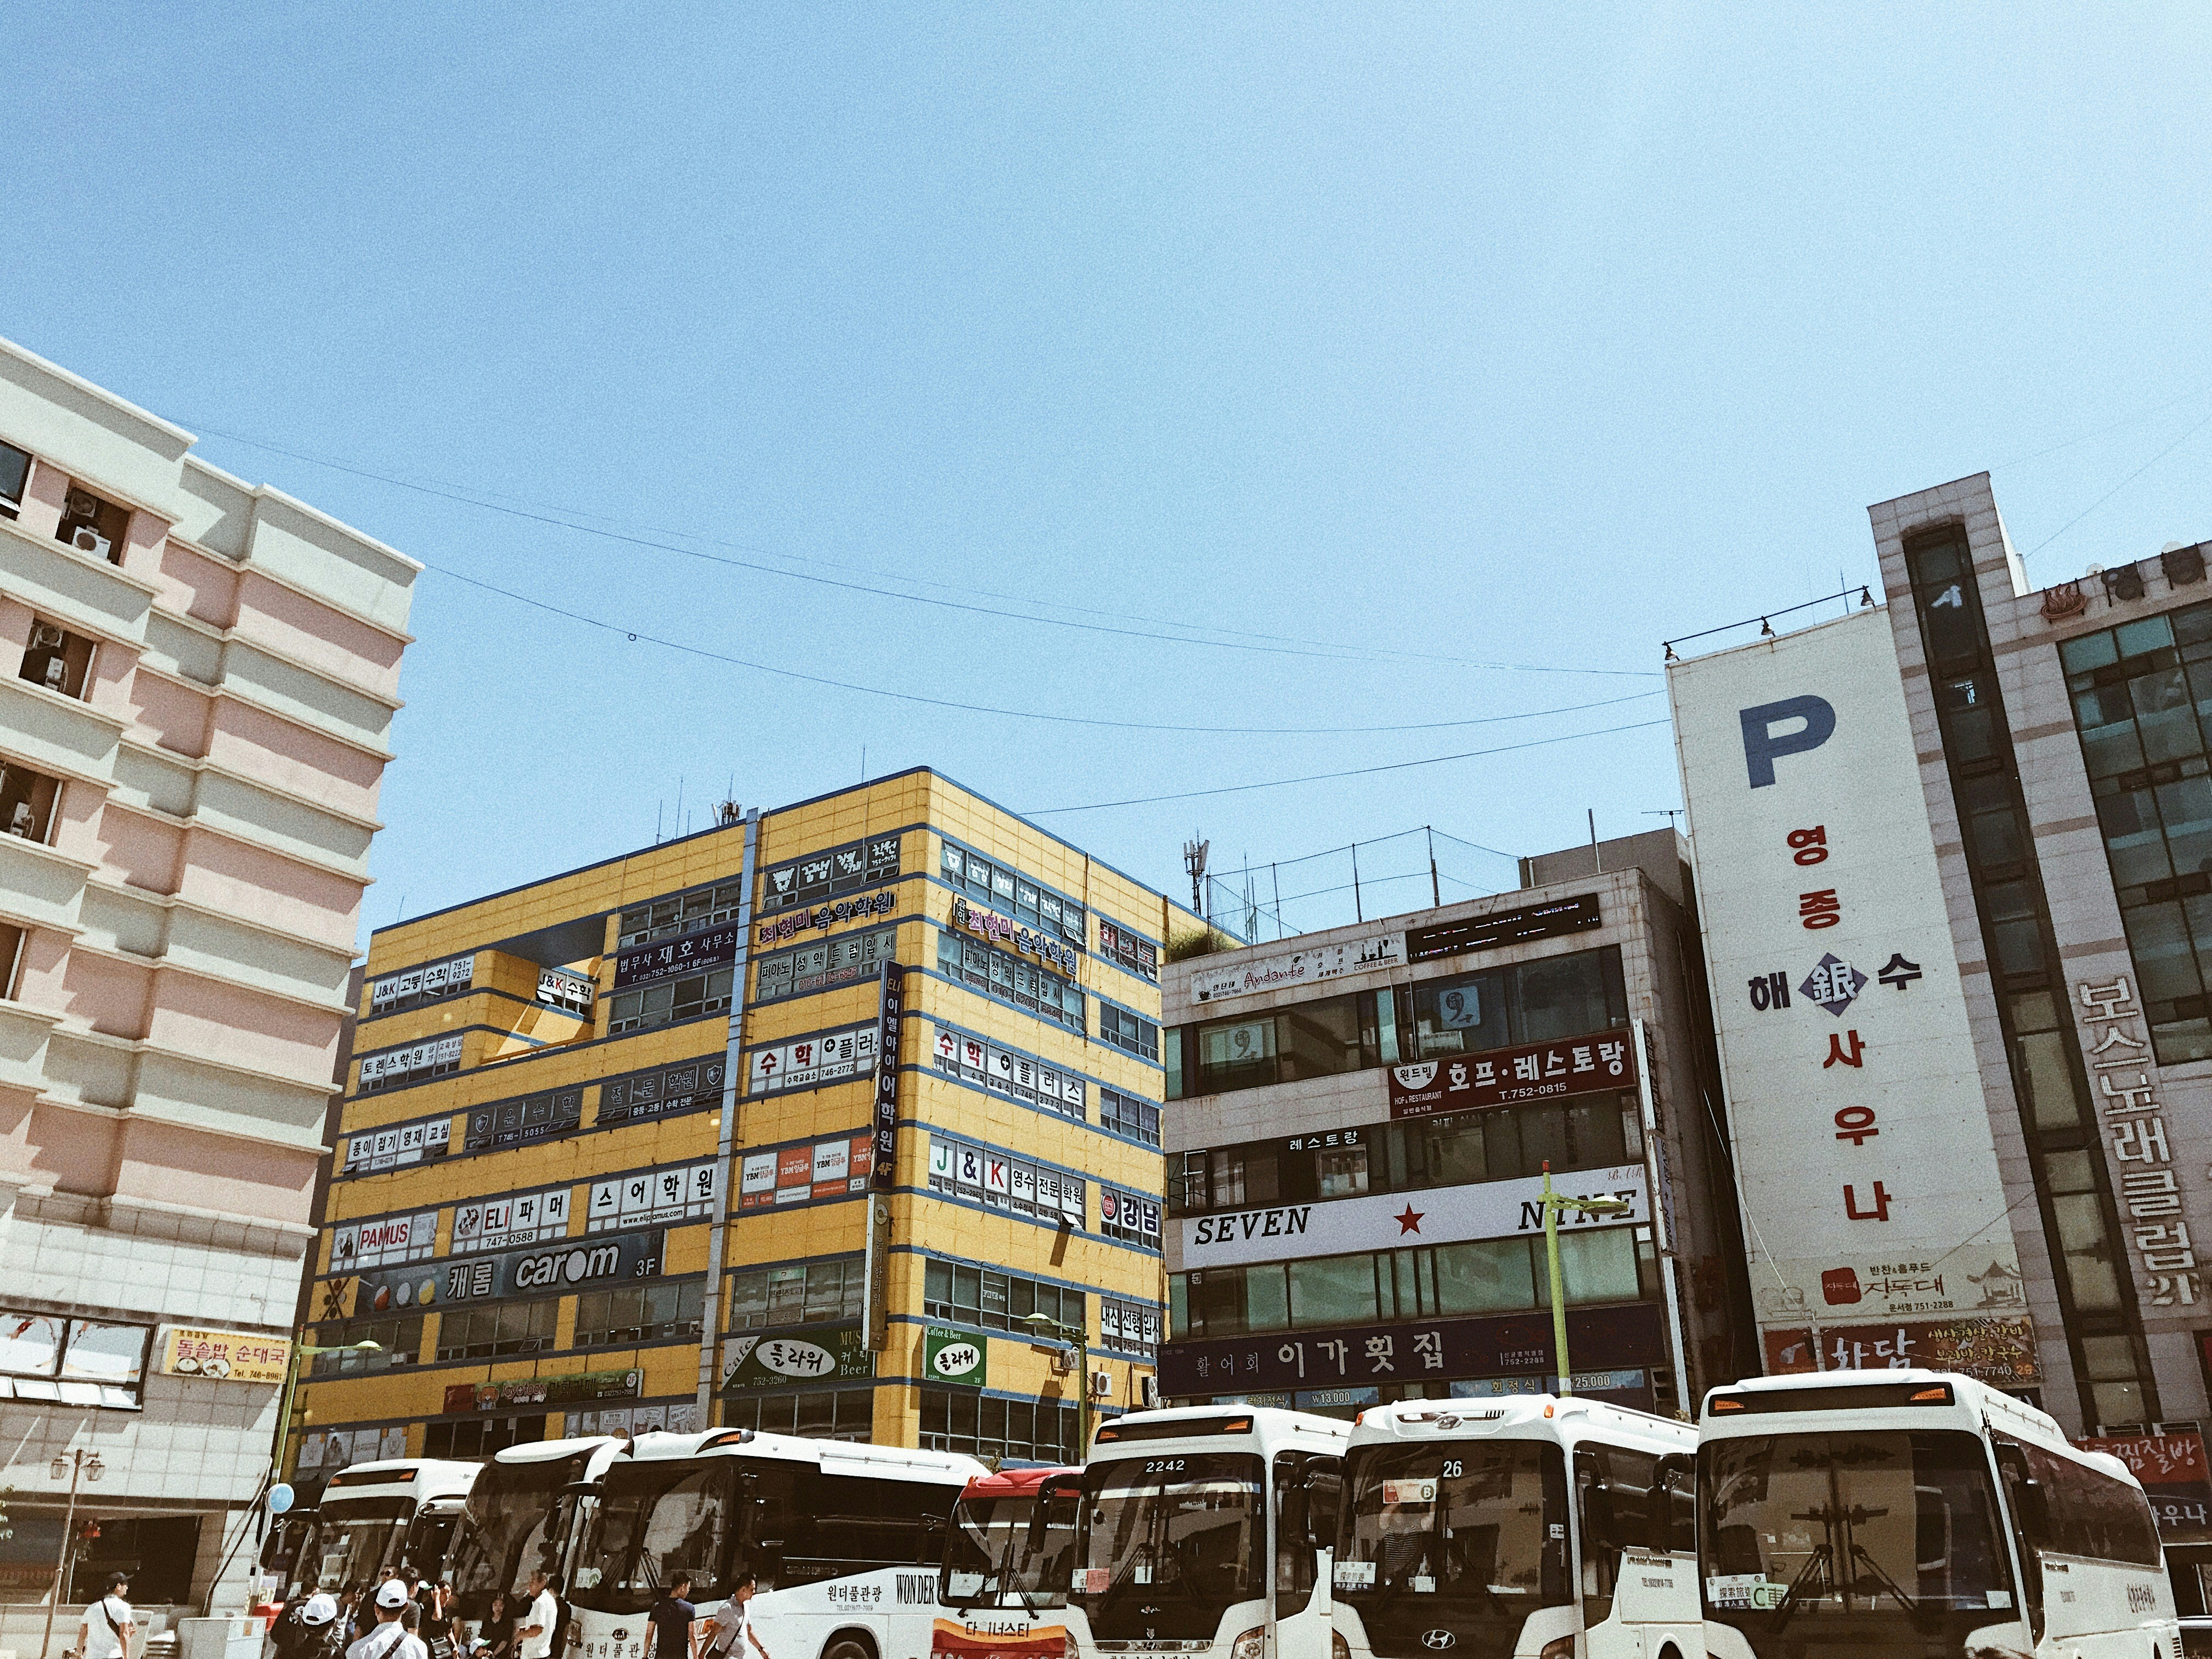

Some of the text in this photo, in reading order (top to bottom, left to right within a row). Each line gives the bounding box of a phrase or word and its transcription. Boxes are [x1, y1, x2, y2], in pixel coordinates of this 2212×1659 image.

[1739, 695, 1836, 789] P
[872, 841, 897, 856] 학원
[760, 891, 892, 944] 최현미 음악학원
[957, 898, 967, 924] 관인
[620, 932, 734, 973] 법무사 재호 사무소
[969, 910, 1077, 976] 최현미 음악학원
[965, 949, 988, 971] 피아노
[1355, 961, 1378, 971] COFFEE
[1384, 957, 1398, 966] BEER
[761, 962, 790, 980] 피아노
[1244, 964, 1305, 989] Andante
[376, 982, 394, 998] J&K
[426, 967, 447, 985] 수학
[540, 973, 591, 1000] J&K 수학
[887, 978, 900, 993] ELI
[761, 1033, 877, 1074] 수학 플러
[821, 1064, 854, 1078] 746-2772
[940, 1032, 1080, 1102] 수학 플러스
[1395, 1091, 1442, 1105] HOF RESTAURANT
[1499, 1082, 1566, 1101] T.752-0815
[1290, 1130, 1358, 1150] 레스토랑
[936, 1145, 1005, 1188] J&K
[485, 1206, 509, 1230] ELI
[1122, 1198, 1159, 1233] 강남
[1195, 1207, 1311, 1245] SEVEN
[360, 1223, 408, 1250] PAMUS
[486, 1231, 533, 1248] 747-0588
[447, 1244, 656, 1299] 캐롬 carom 3F
[1914, 1301, 1954, 1311] 751-2288
[840, 1330, 861, 1346] MUS
[927, 1326, 944, 1338] Coffee
[949, 1331, 961, 1340] Beer
[236, 1345, 285, 1365] 순대국
[840, 1364, 868, 1376] Beer
[753, 1375, 787, 1386] 752-3260
[1146, 1460, 1185, 1472] 2242
[1443, 1460, 1462, 1478] 26
[827, 1585, 882, 1602] 원더풀관광
